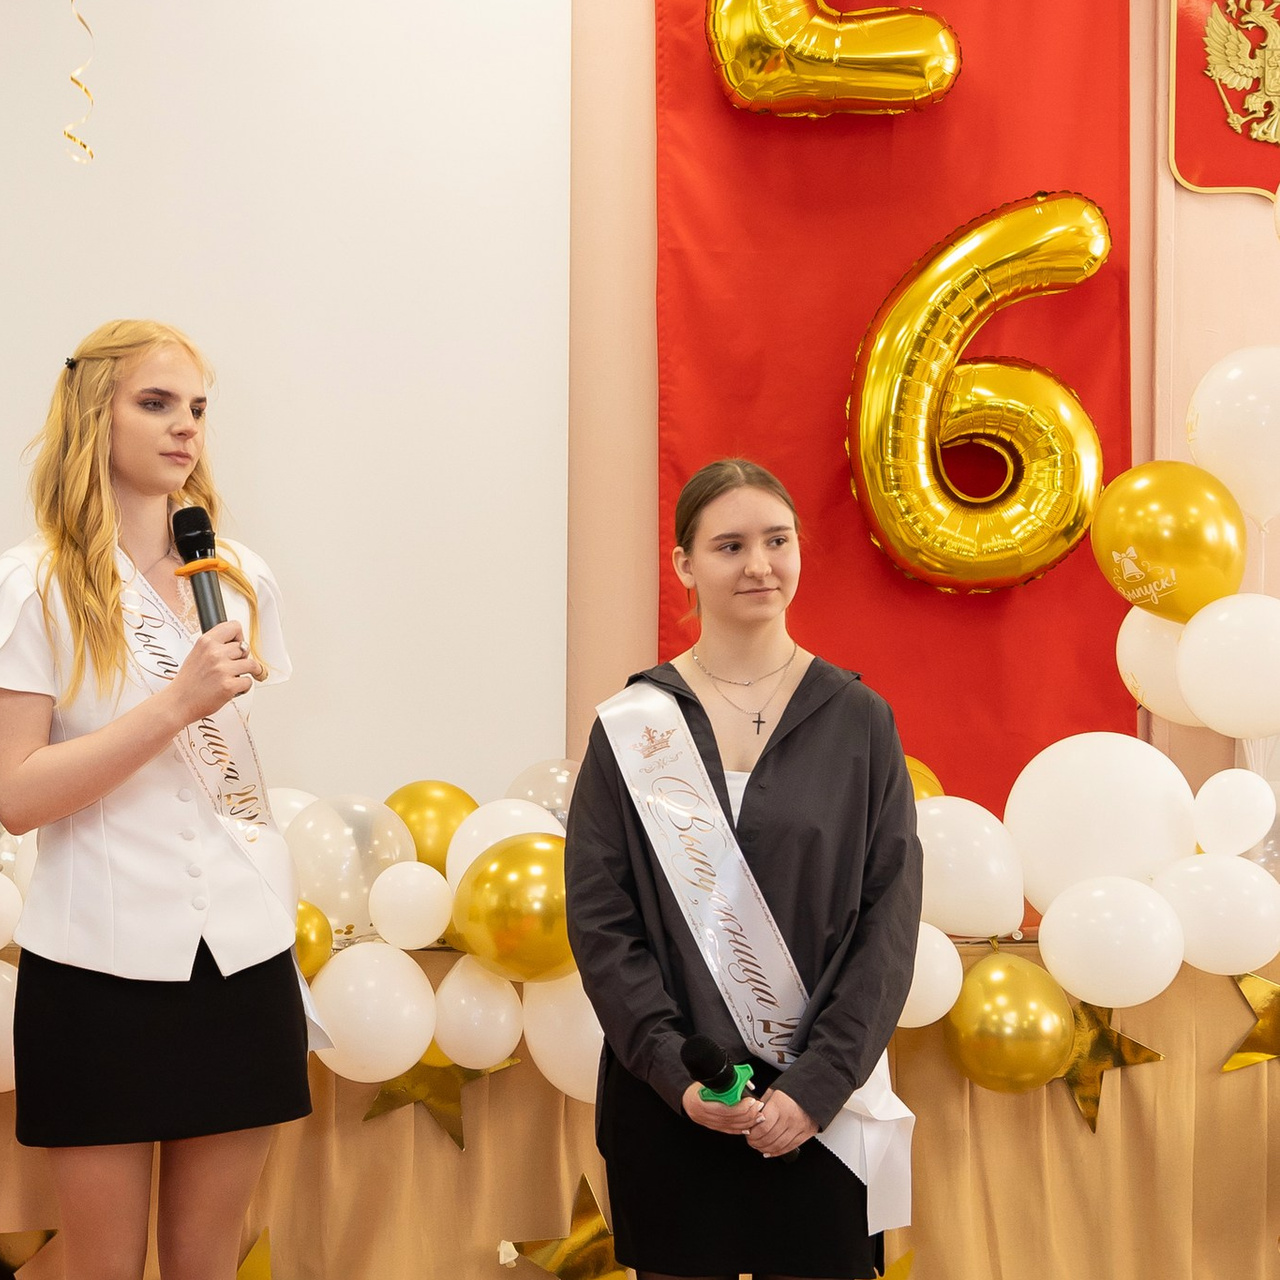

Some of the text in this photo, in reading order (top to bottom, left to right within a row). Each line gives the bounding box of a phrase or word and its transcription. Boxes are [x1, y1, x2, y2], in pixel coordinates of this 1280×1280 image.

[845, 190, 1112, 595] 6
[650, 776, 802, 1065] Выпускница 202
